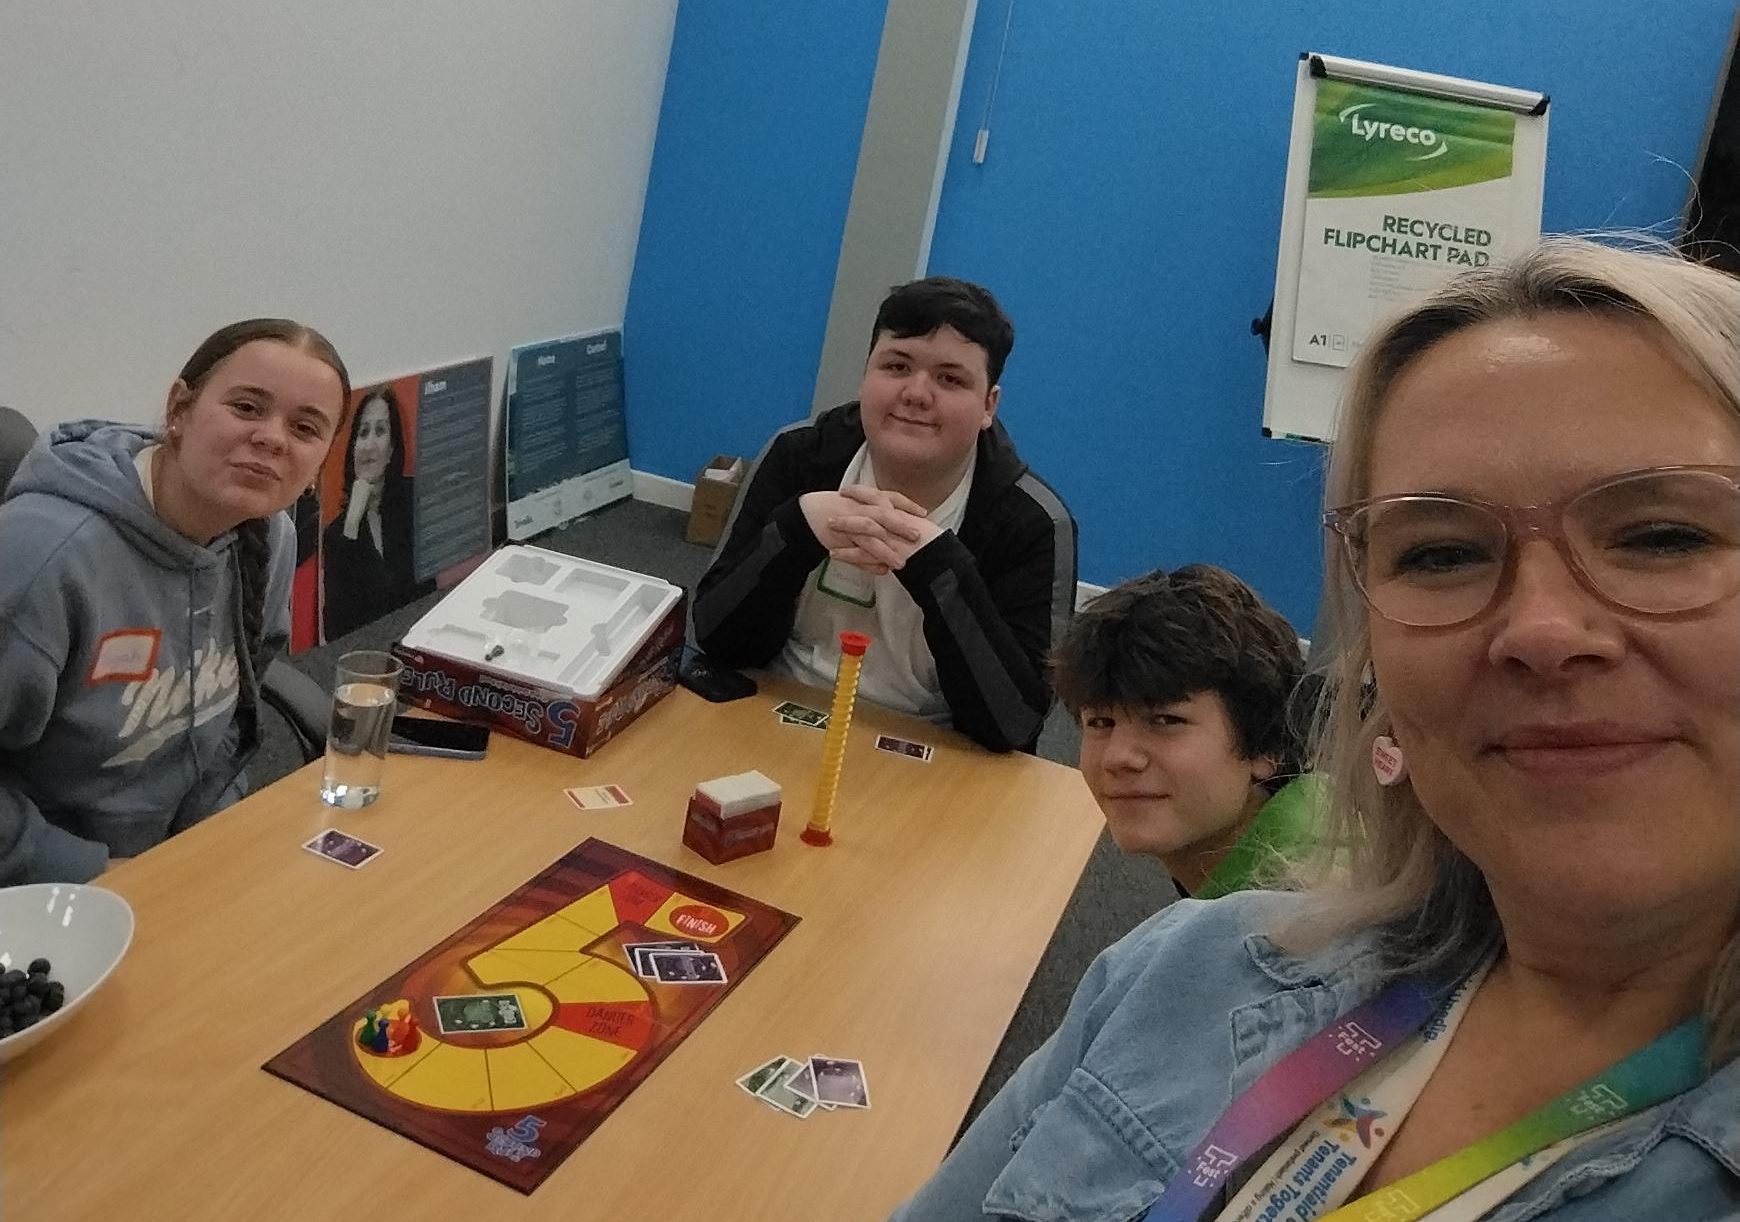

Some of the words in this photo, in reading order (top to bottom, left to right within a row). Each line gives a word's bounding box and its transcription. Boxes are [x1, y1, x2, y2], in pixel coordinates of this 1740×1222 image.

[1352, 113, 1436, 146] Lyreco
[1323, 228, 1442, 260] FLIPCHART
[1446, 247, 1490, 268] PAD
[1382, 215, 1492, 247] RECYCLED
[1309, 334, 1327, 346] A1
[400, 665, 456, 701] RULE
[458, 685, 545, 734] SECOND
[546, 700, 581, 749] 5
[676, 914, 717, 935] FINISH
[1293, 1139, 1340, 1186] Tenants
[1255, 1185, 1301, 1222] Toget
